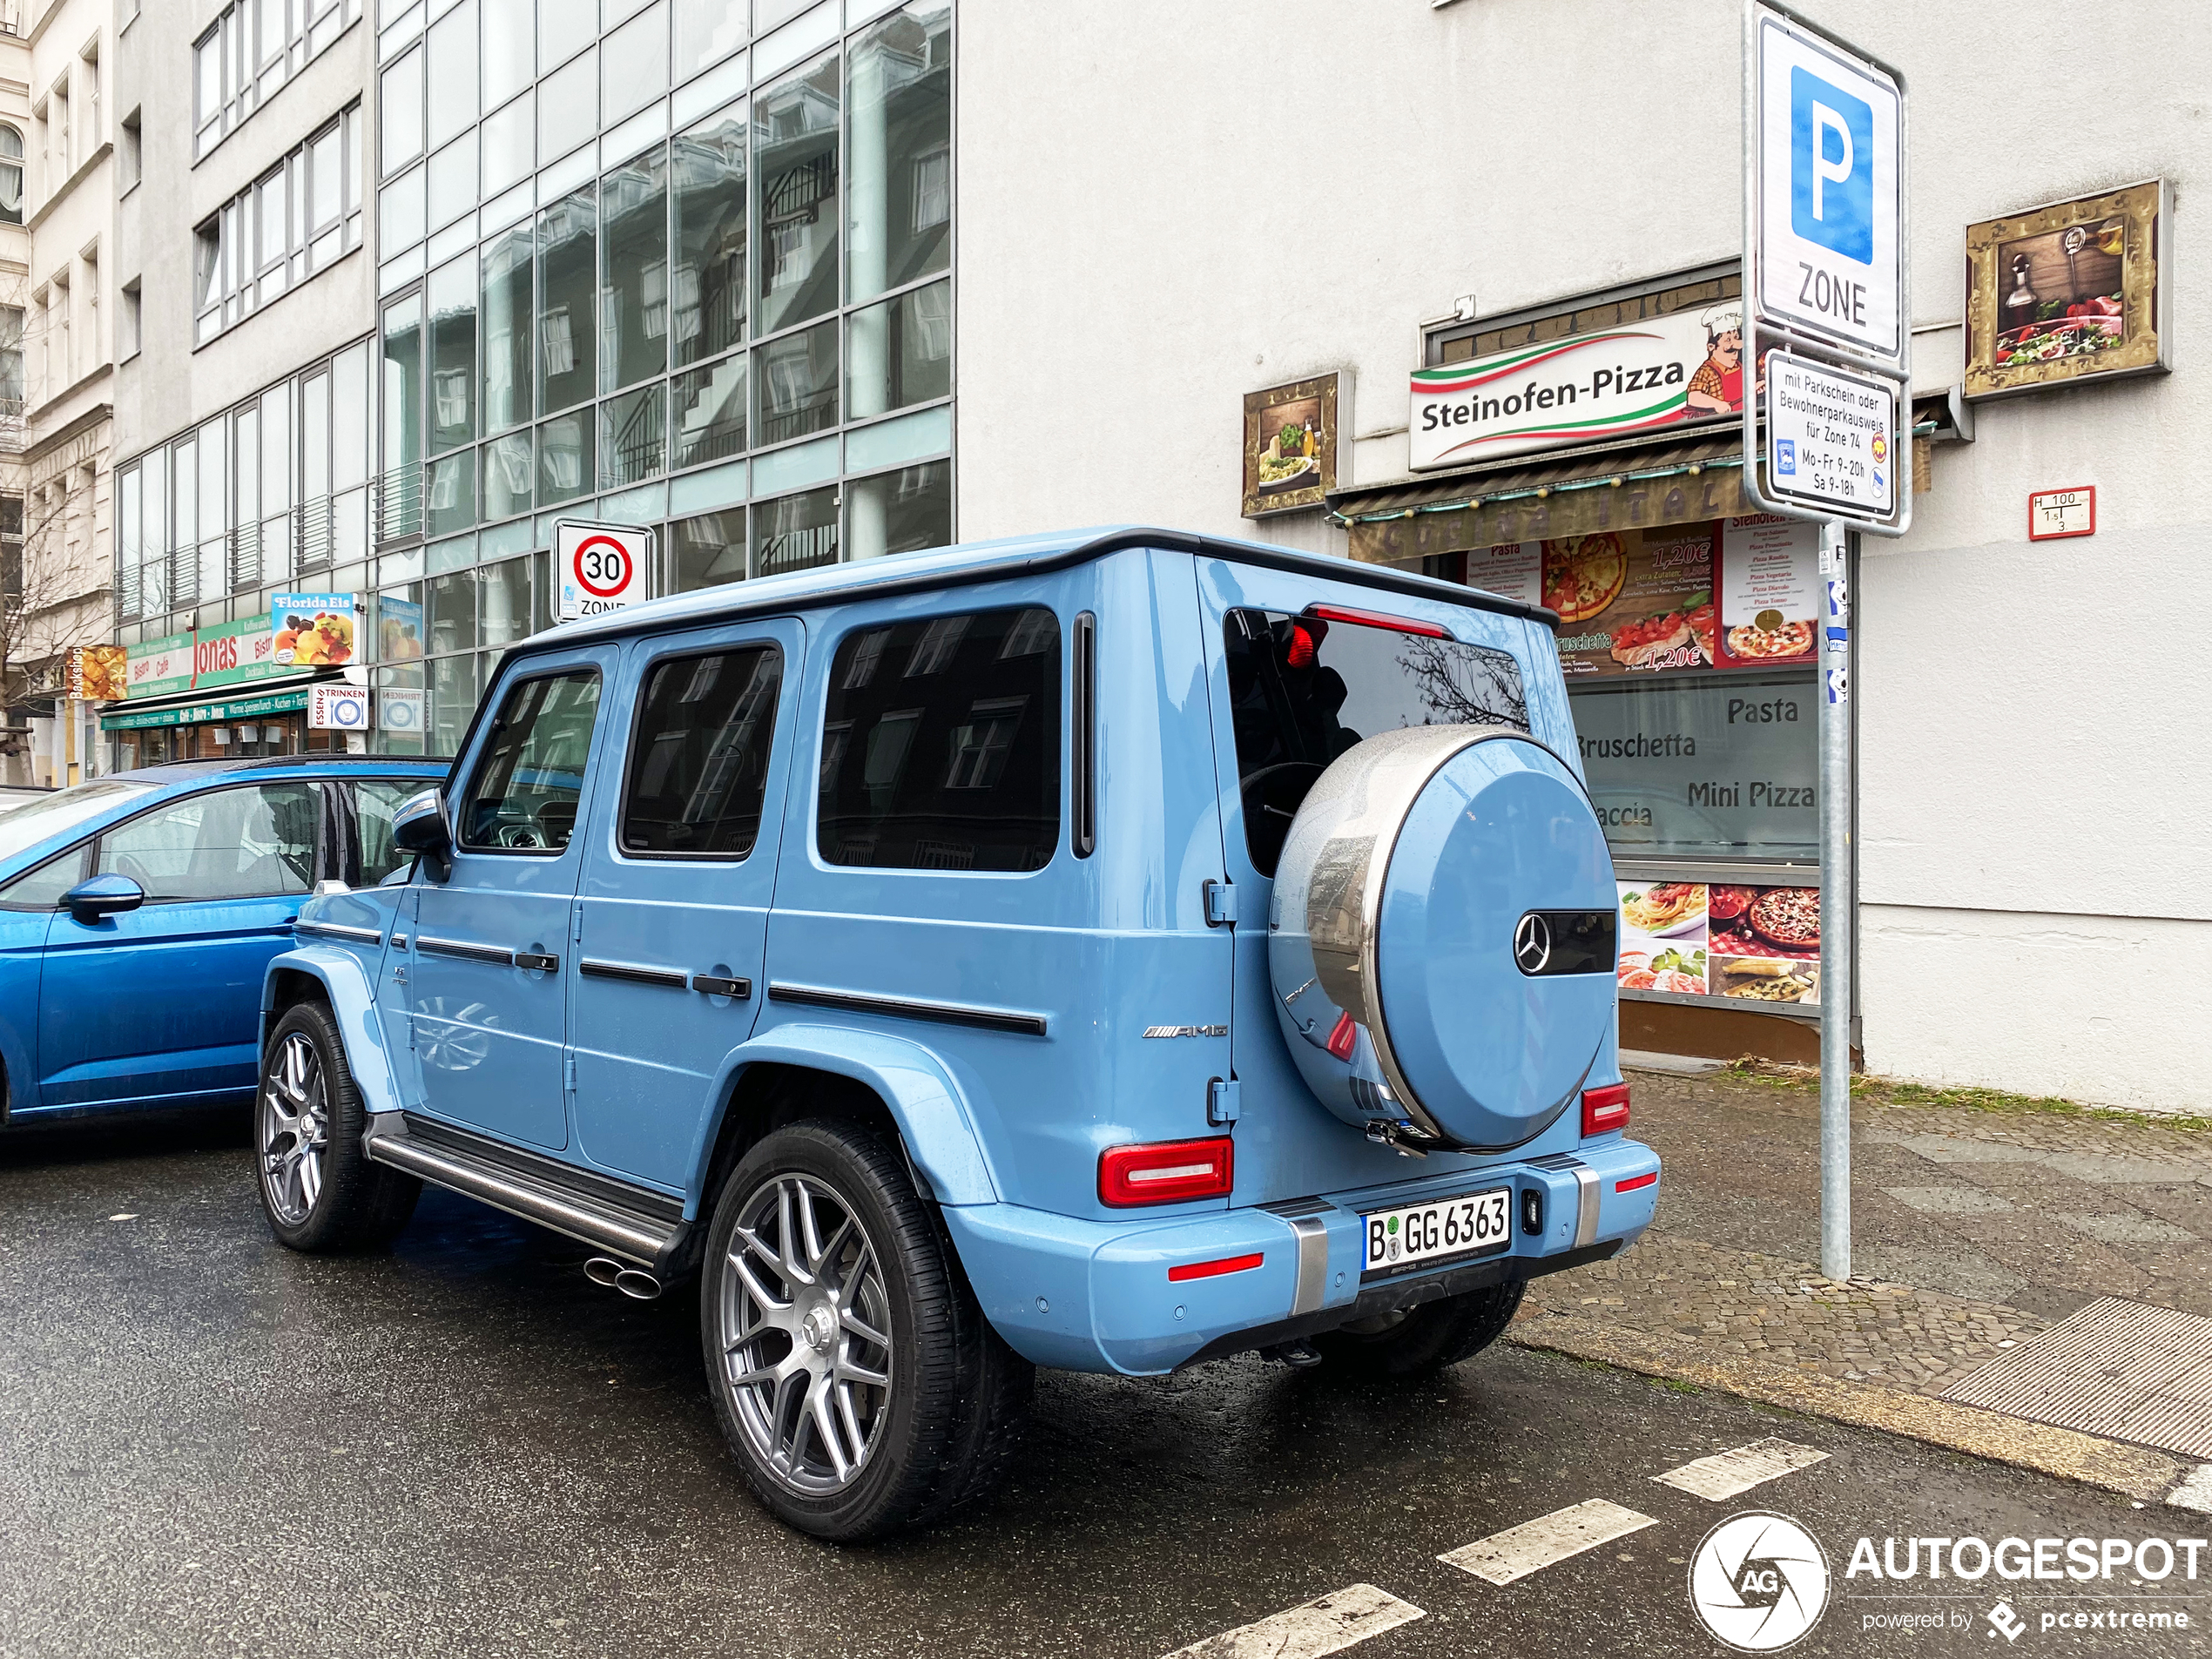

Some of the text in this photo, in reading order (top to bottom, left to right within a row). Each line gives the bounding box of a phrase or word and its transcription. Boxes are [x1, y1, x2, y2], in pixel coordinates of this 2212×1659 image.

[1812, 98, 1854, 222] P
[1798, 260, 1867, 328] ZONE
[1421, 361, 1685, 432] Steinofen-Pizza
[1785, 372, 1879, 411] mit Parkschein oder
[1780, 391, 1884, 434] Bewohnerparkausweis
[1806, 421, 1821, 440] für
[1824, 426, 1847, 446] Zone
[1850, 432, 1861, 449] 74
[1814, 473, 1855, 497] Sa 9-18h
[2034, 493, 2075, 508] H 100
[1491, 543, 1521, 556] Pasta
[1652, 542, 1711, 570] 1,20€
[586, 551, 619, 581] 30
[274, 596, 350, 609] Florida Eis
[190, 630, 237, 690] Jonas
[254, 636, 272, 660] Bistr
[1645, 645, 1703, 671] 1,20€
[70, 647, 85, 699] Backshop
[325, 689, 365, 698] TRINKEN
[1728, 698, 1798, 724] Pasta
[1688, 781, 1815, 807] Mini Pizza
[1598, 801, 1653, 826] accia
[1165, 1024, 1228, 1038] AMG
[1370, 1219, 1386, 1262] B
[1444, 1197, 1504, 1246] 6363
